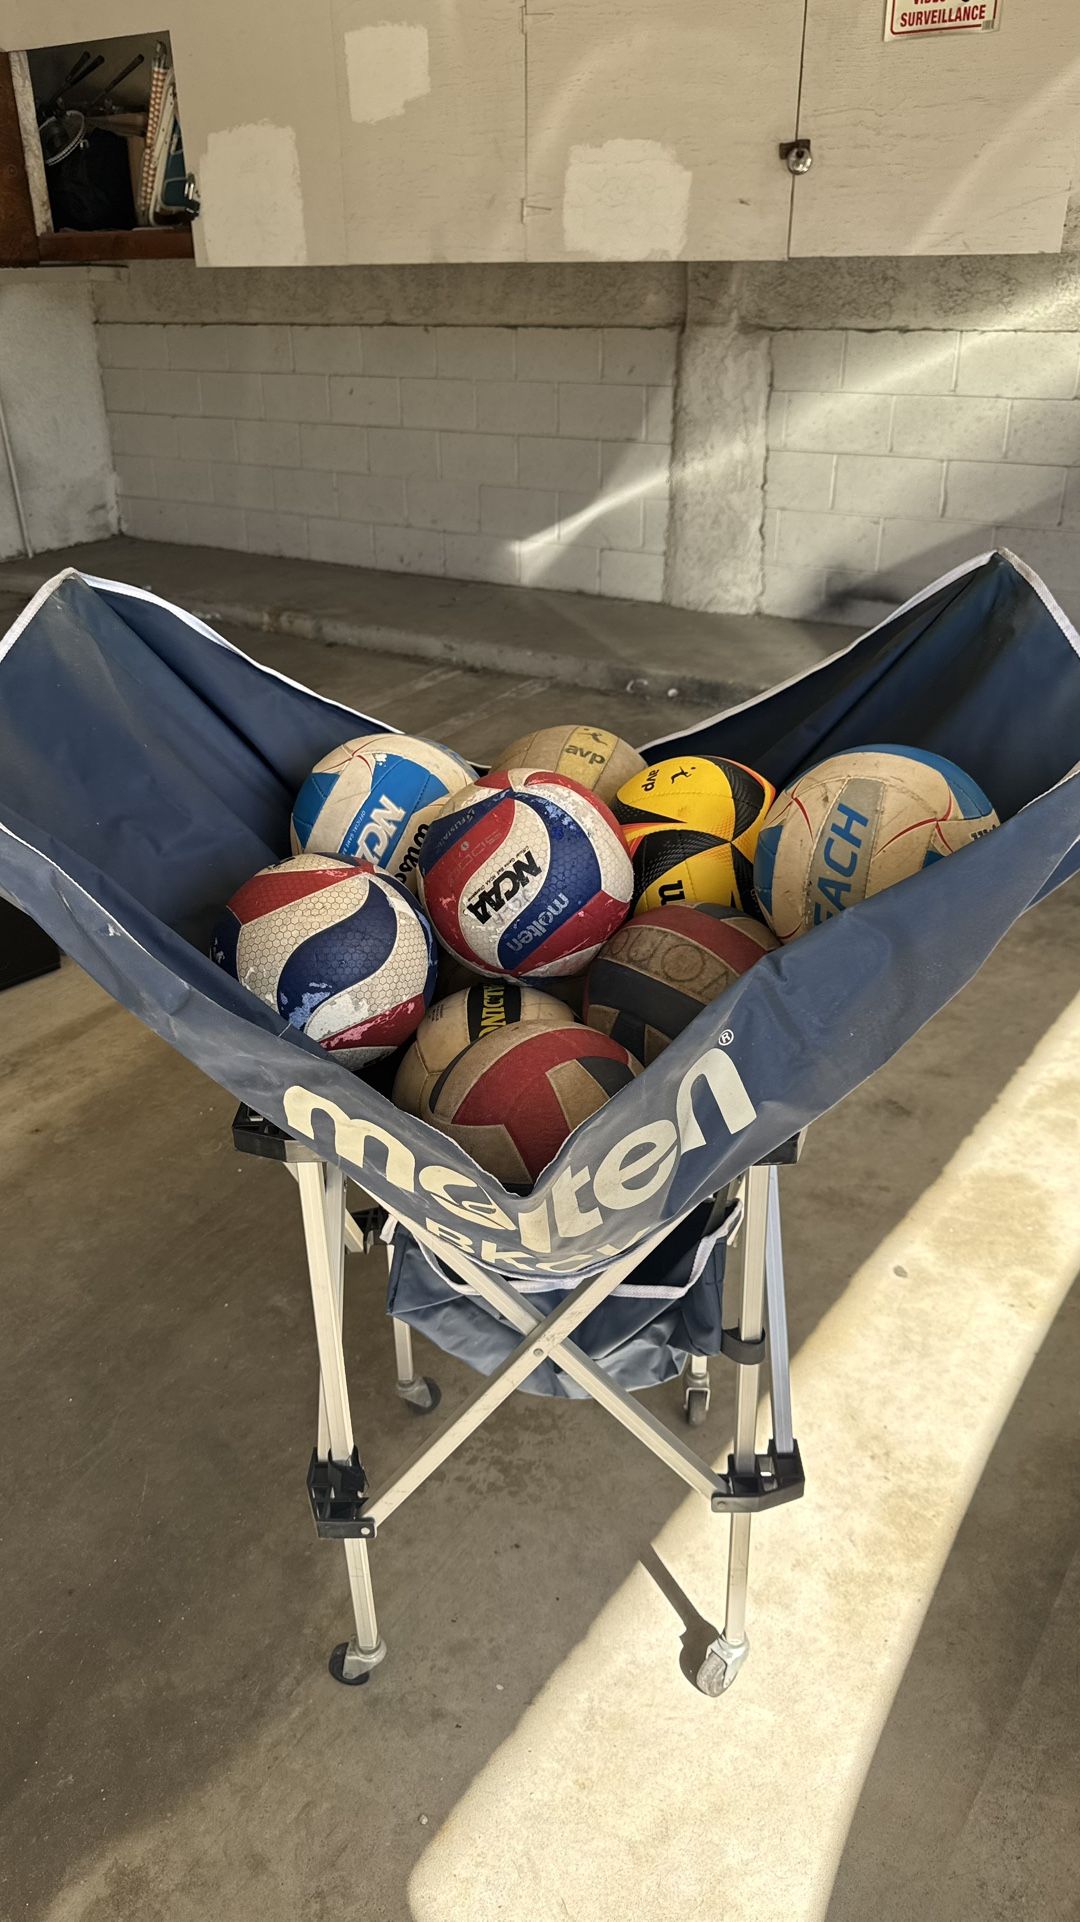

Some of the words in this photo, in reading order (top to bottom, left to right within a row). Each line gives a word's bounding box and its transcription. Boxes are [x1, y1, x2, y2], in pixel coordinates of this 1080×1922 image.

[900, 4, 986, 27] SURVEILLANCE
[565, 744, 605, 765] avp
[641, 769, 660, 792] avp
[354, 794, 407, 866] NCA
[466, 850, 543, 925] NCAA
[506, 892, 570, 952] molten
[283, 1047, 757, 1254] molten
